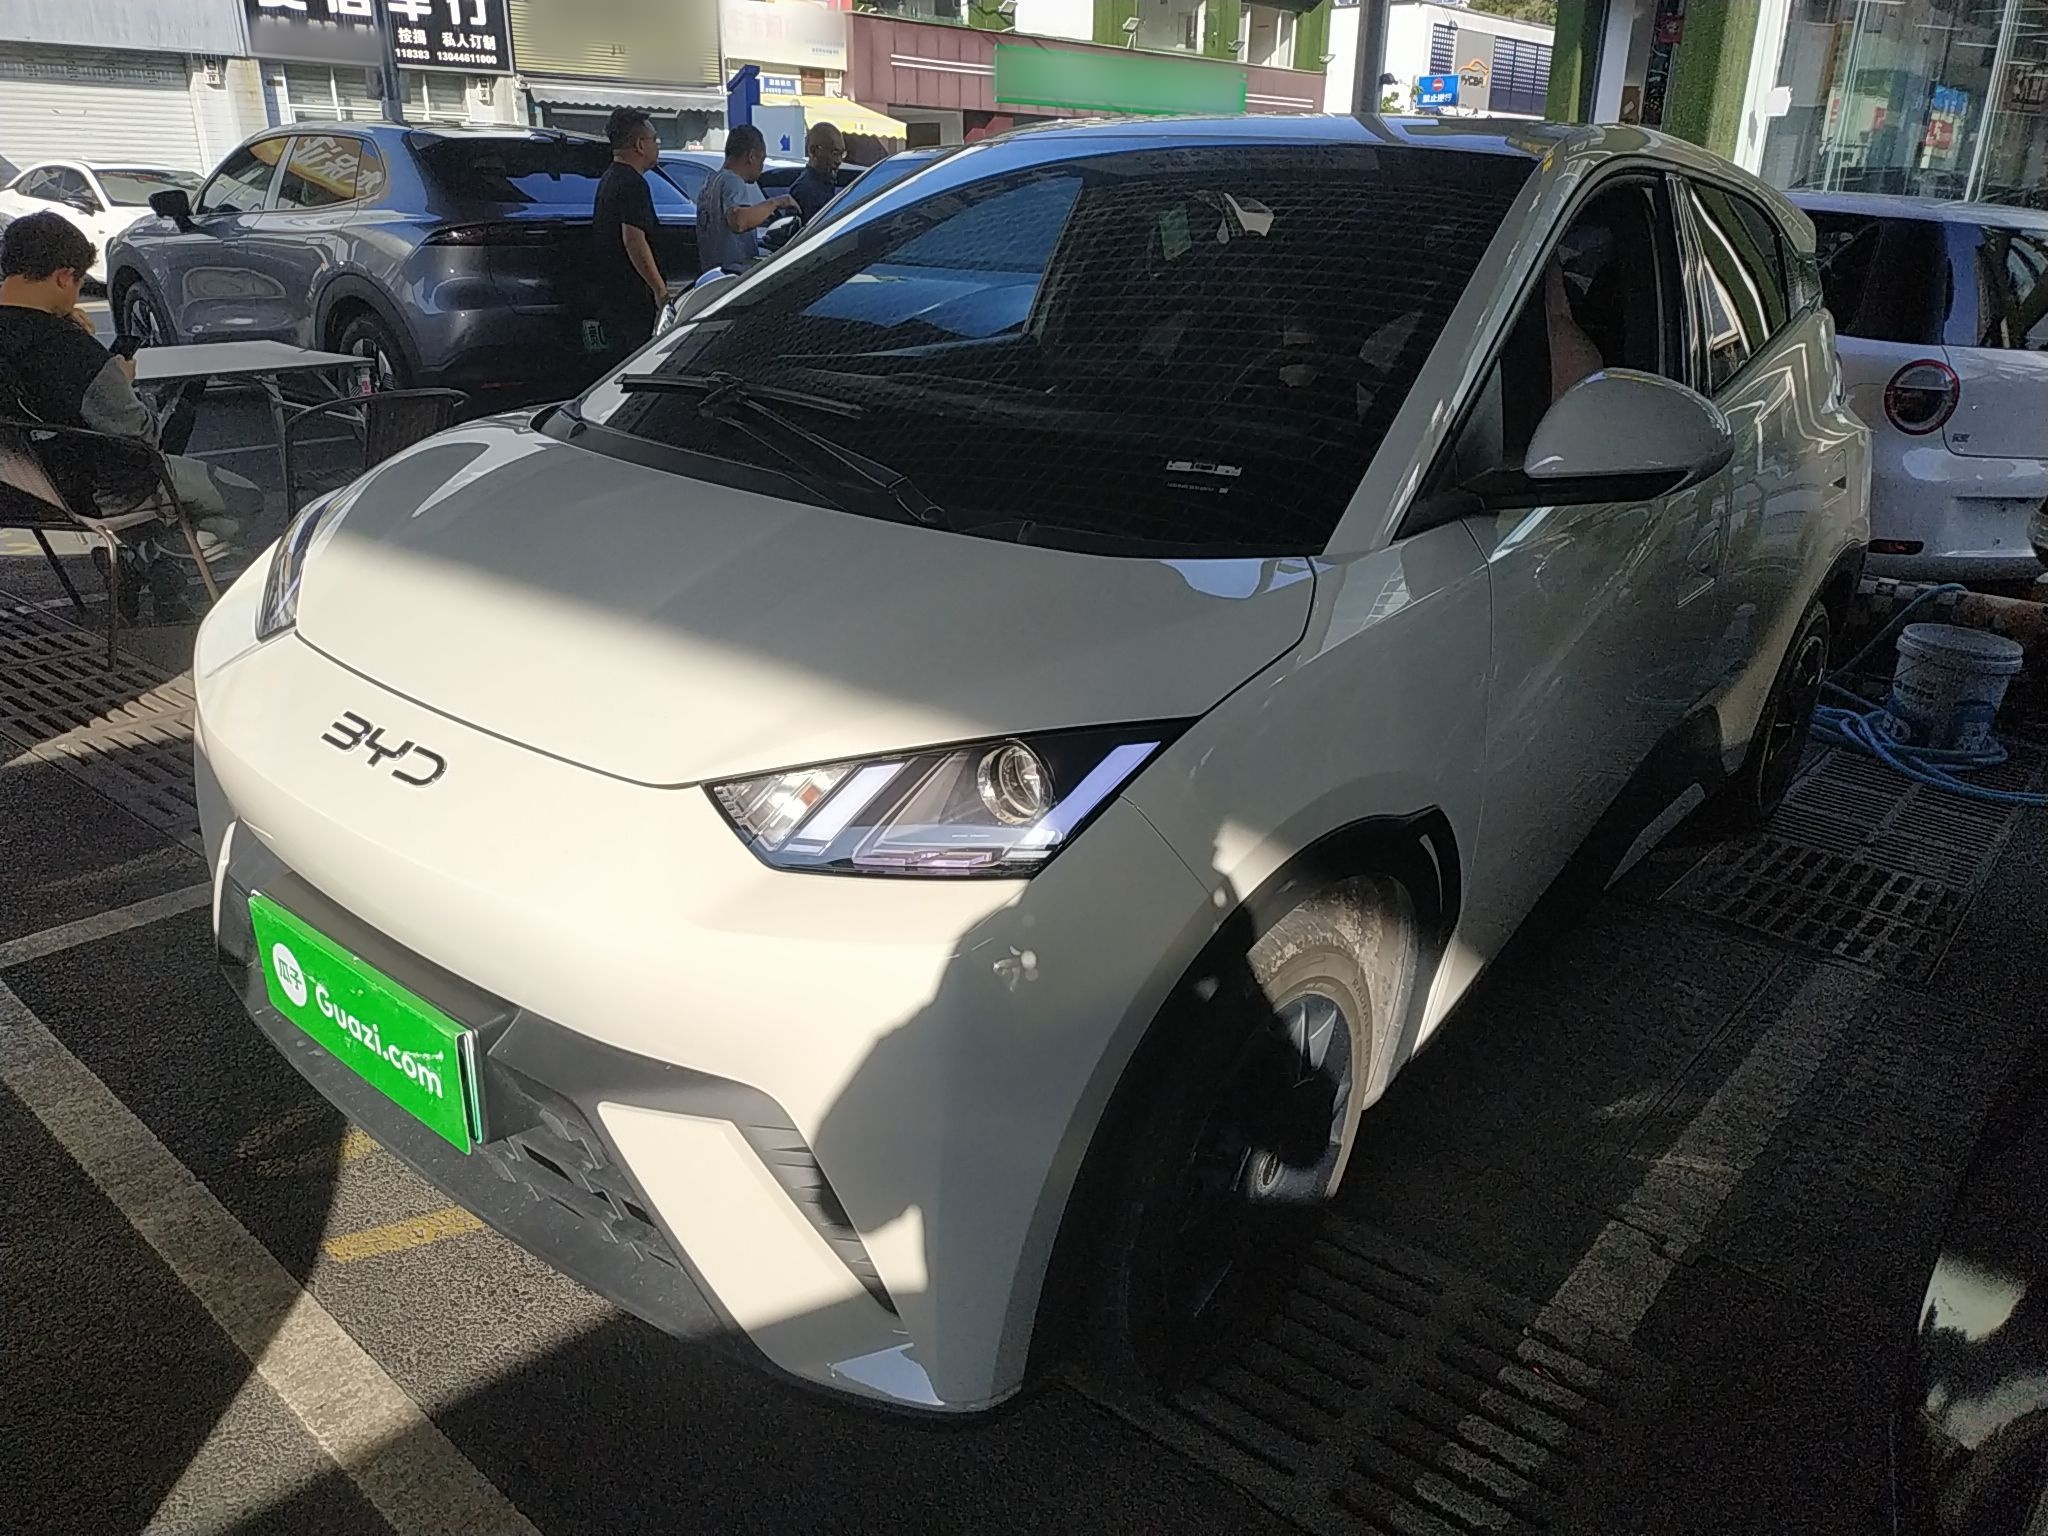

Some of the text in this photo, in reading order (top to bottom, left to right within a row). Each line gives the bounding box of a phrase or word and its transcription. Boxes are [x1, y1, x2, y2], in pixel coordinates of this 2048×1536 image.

[398, 27, 497, 51] 按揭 私人订制
[321, 710, 447, 787] BYD
[278, 957, 303, 991] 瓜子
[315, 985, 444, 1099] Guazi.com
